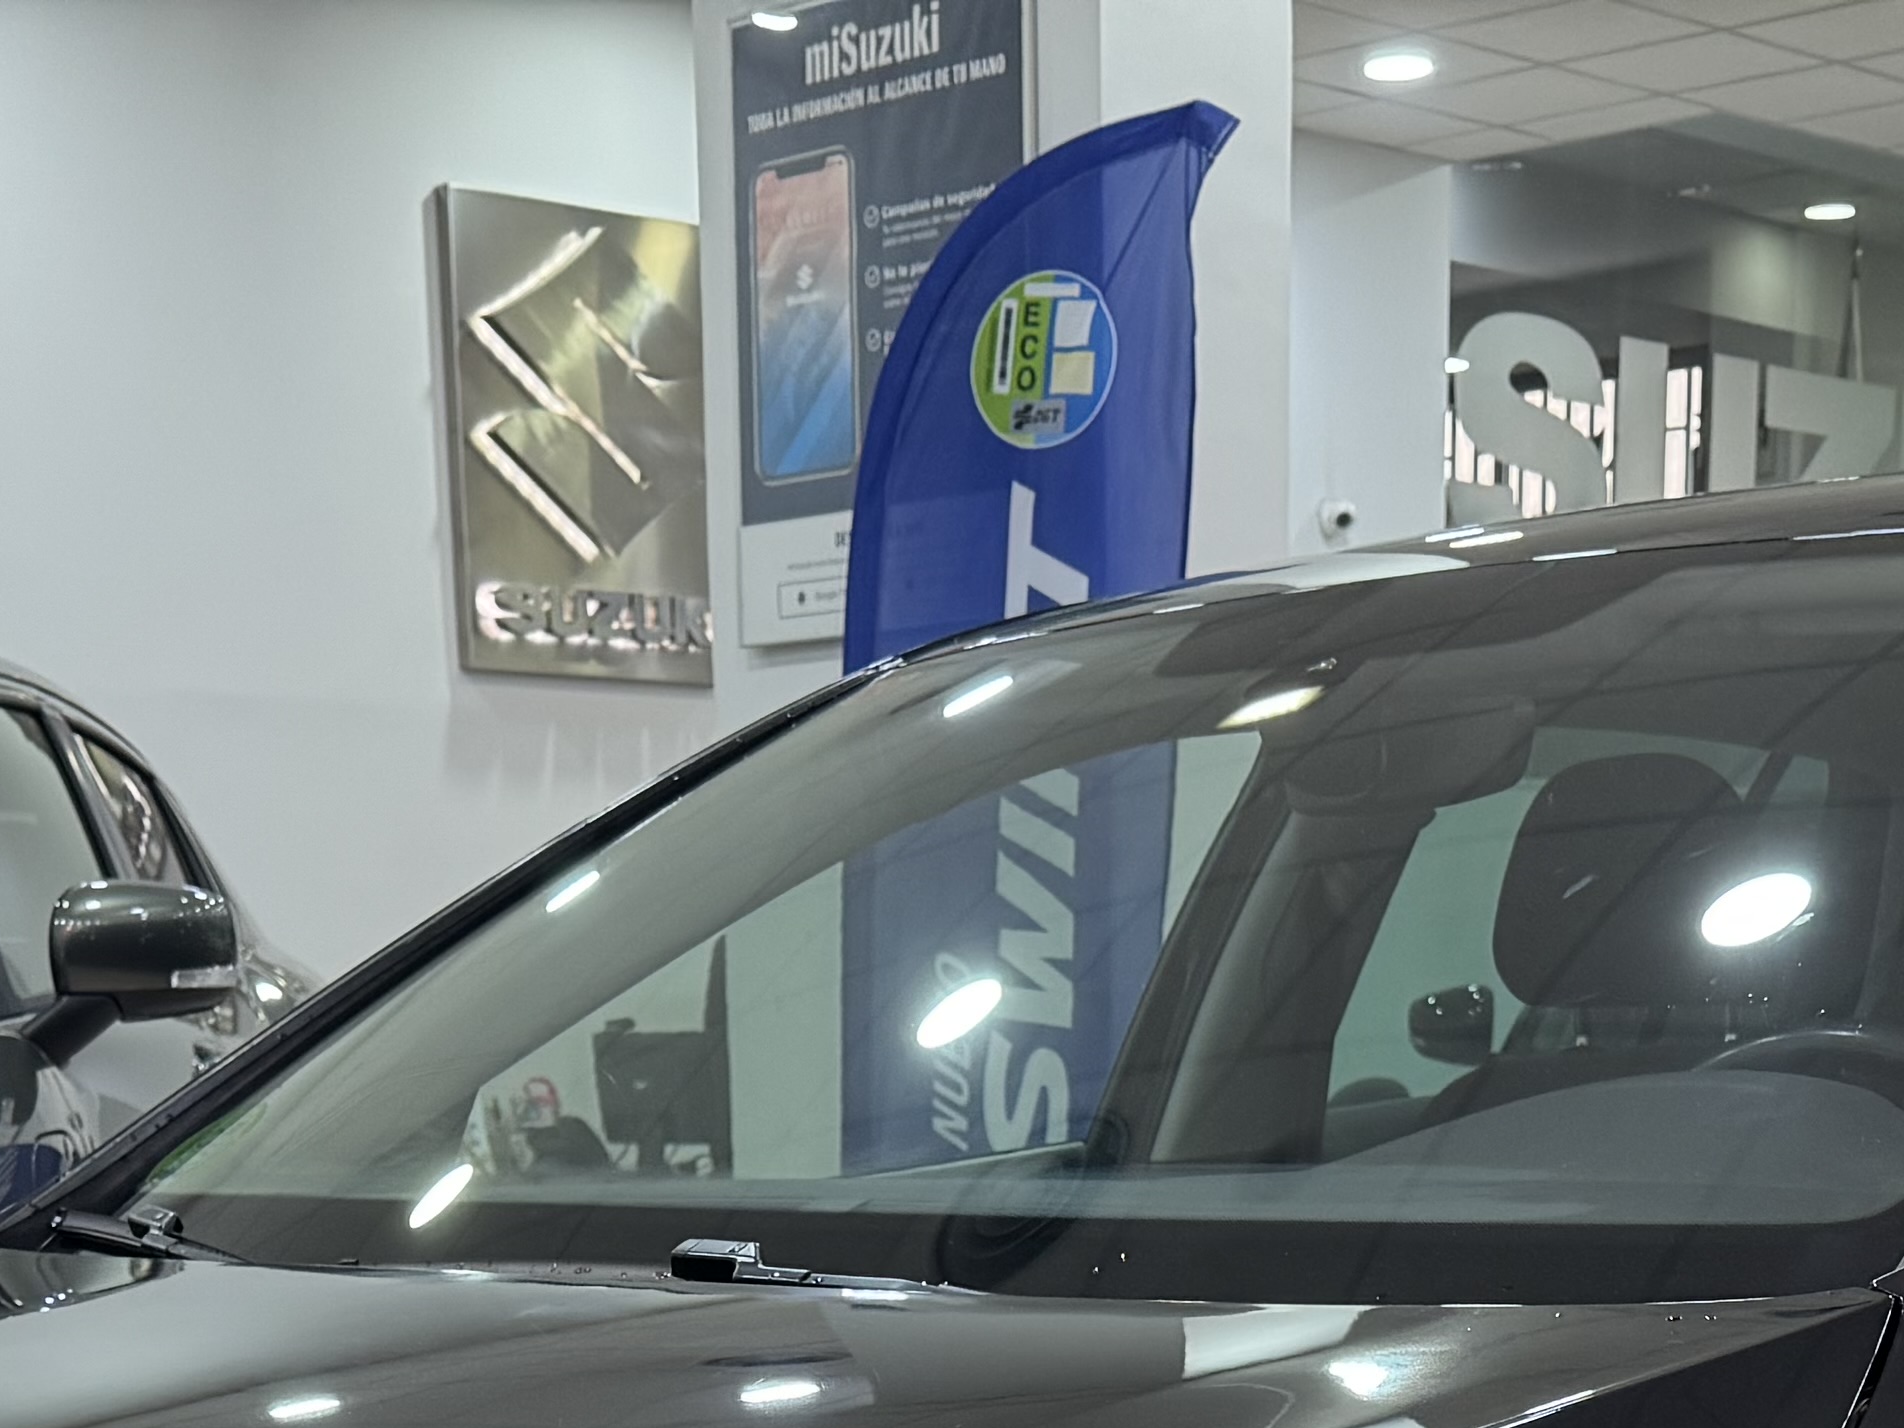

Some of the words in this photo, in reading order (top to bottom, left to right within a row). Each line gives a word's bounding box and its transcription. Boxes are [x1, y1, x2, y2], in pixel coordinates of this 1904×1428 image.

[804, 1, 940, 86] miSuzuki
[776, 106, 791, 126] LA
[867, 83, 882, 105] AL
[884, 71, 933, 101] ALCANCE
[935, 67, 951, 90] DE
[969, 53, 1007, 82] MANO
[1017, 302, 1041, 391] ECO
